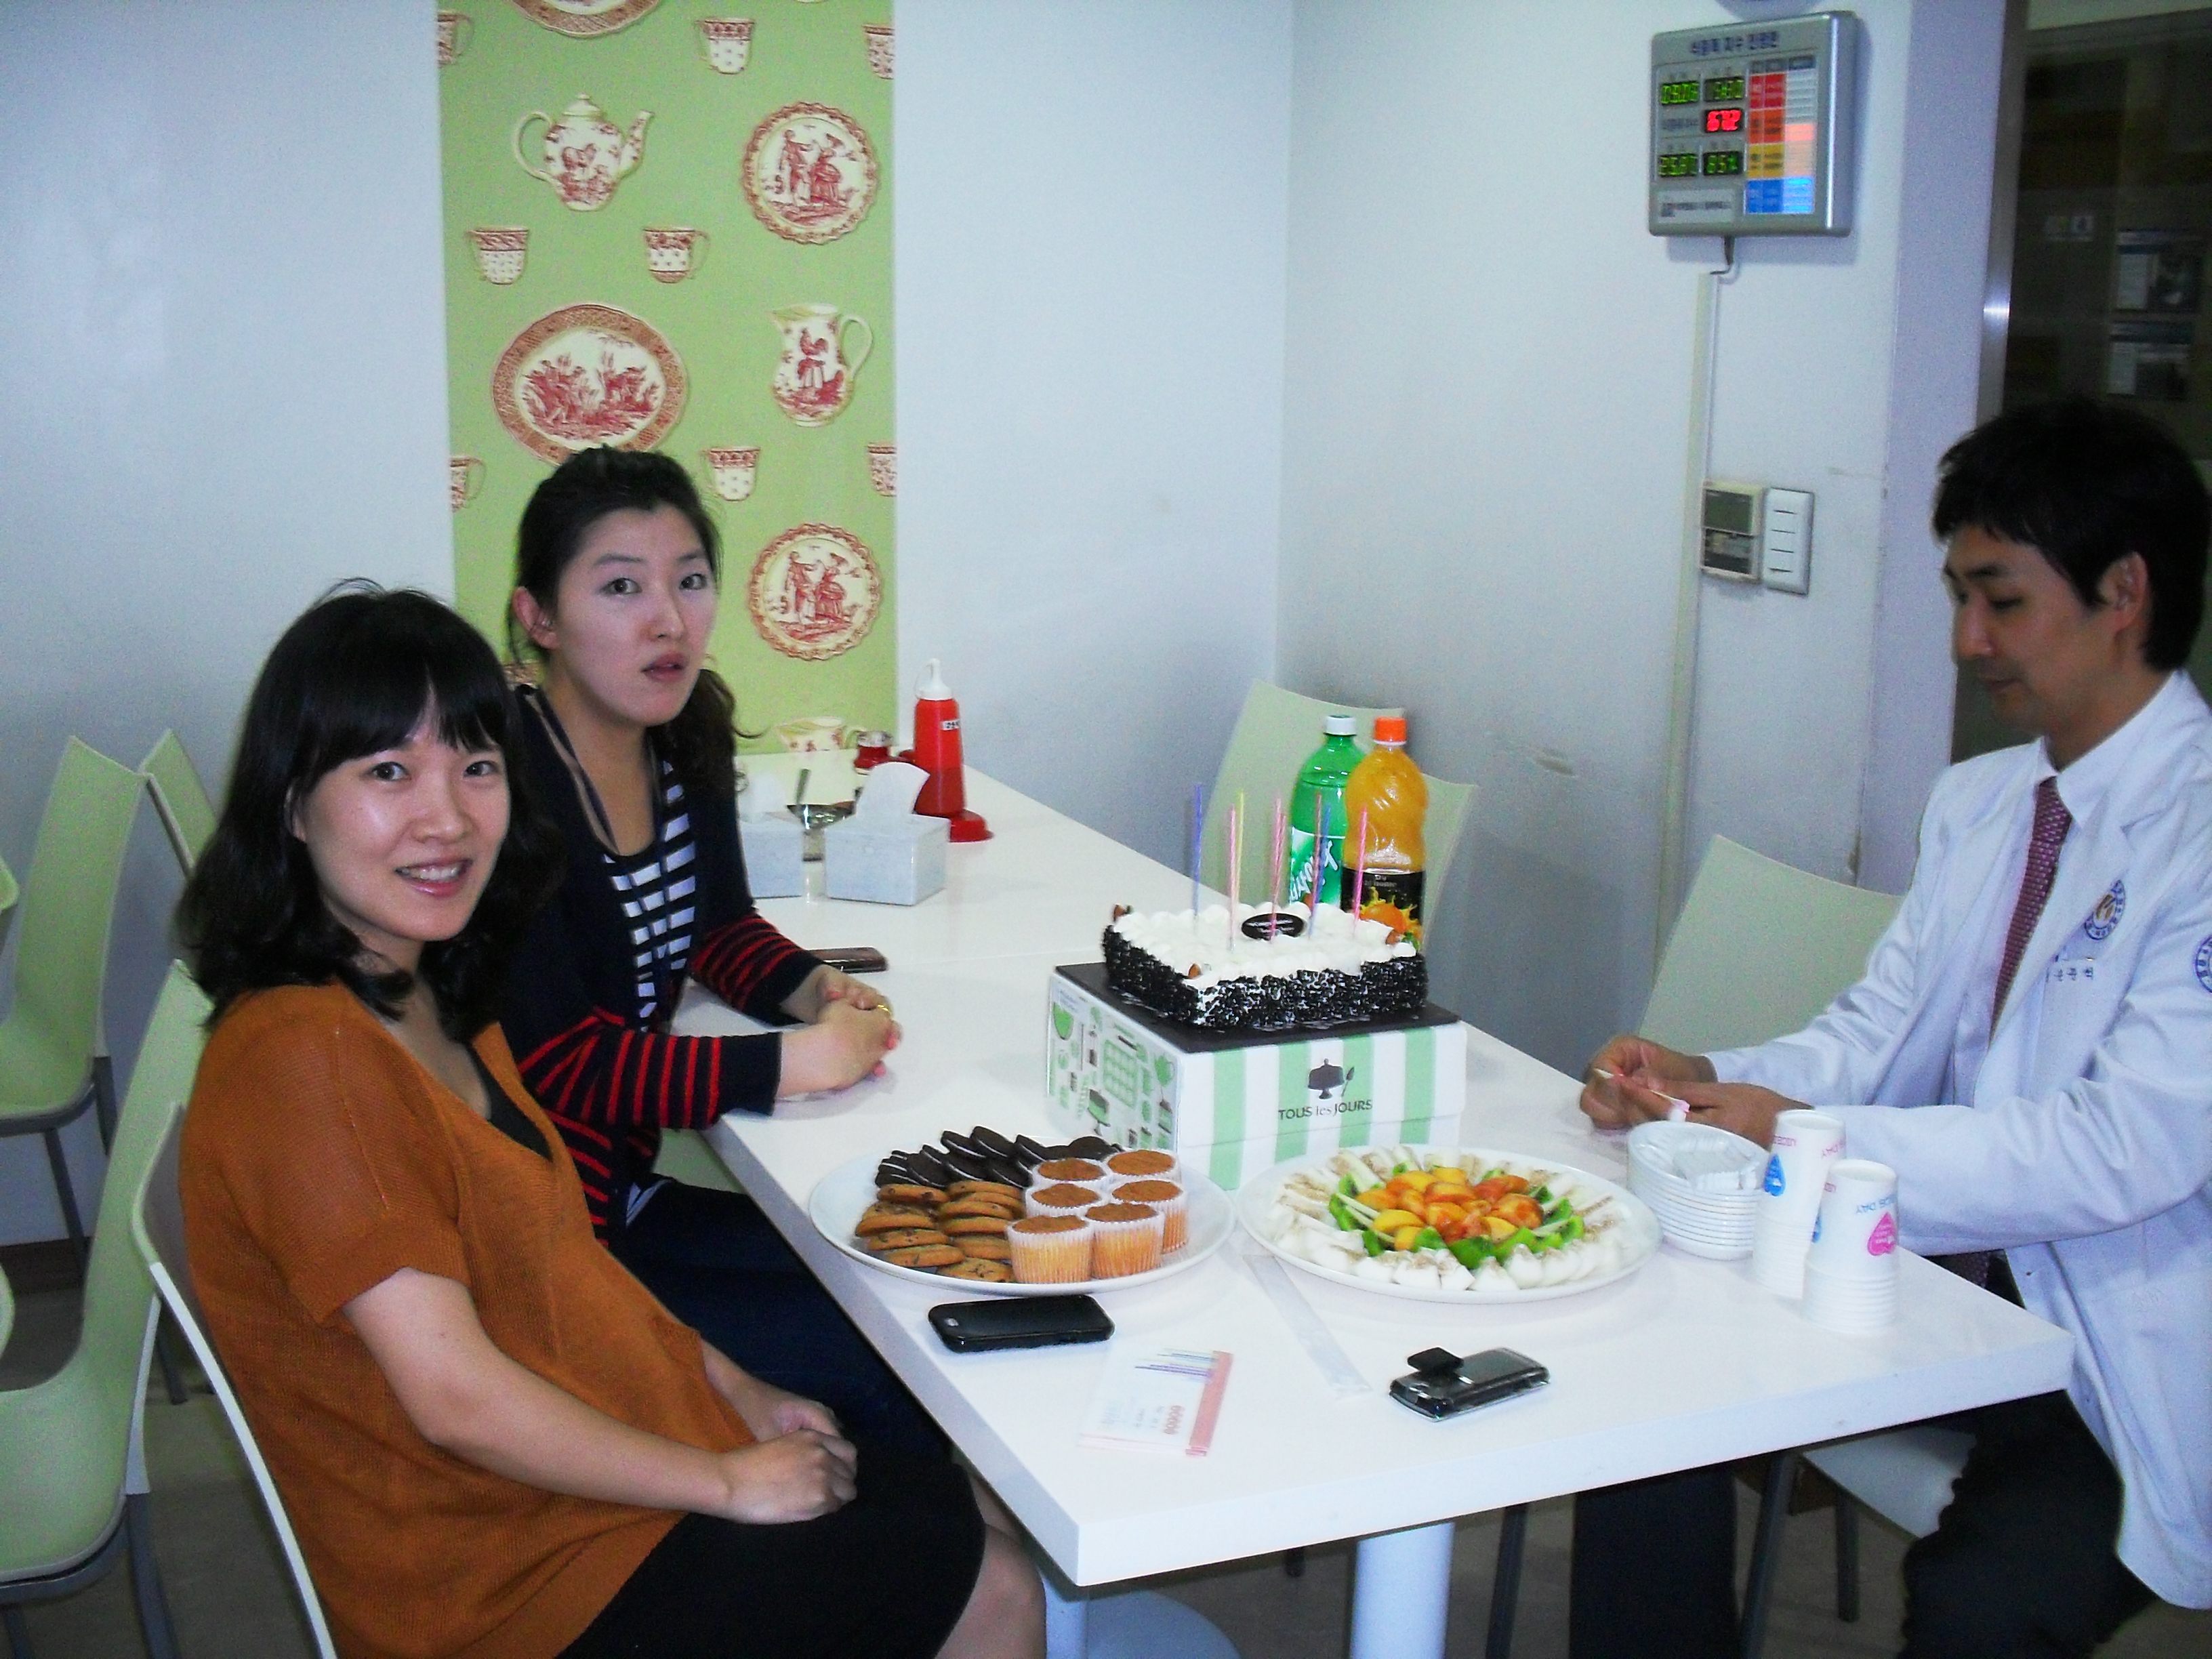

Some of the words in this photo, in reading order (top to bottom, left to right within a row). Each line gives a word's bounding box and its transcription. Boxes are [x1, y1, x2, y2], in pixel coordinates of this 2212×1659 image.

[1278, 1106, 1313, 1120] TOUS
[1316, 1105, 1332, 1116] les
[1333, 1099, 1373, 1117] JOURS
